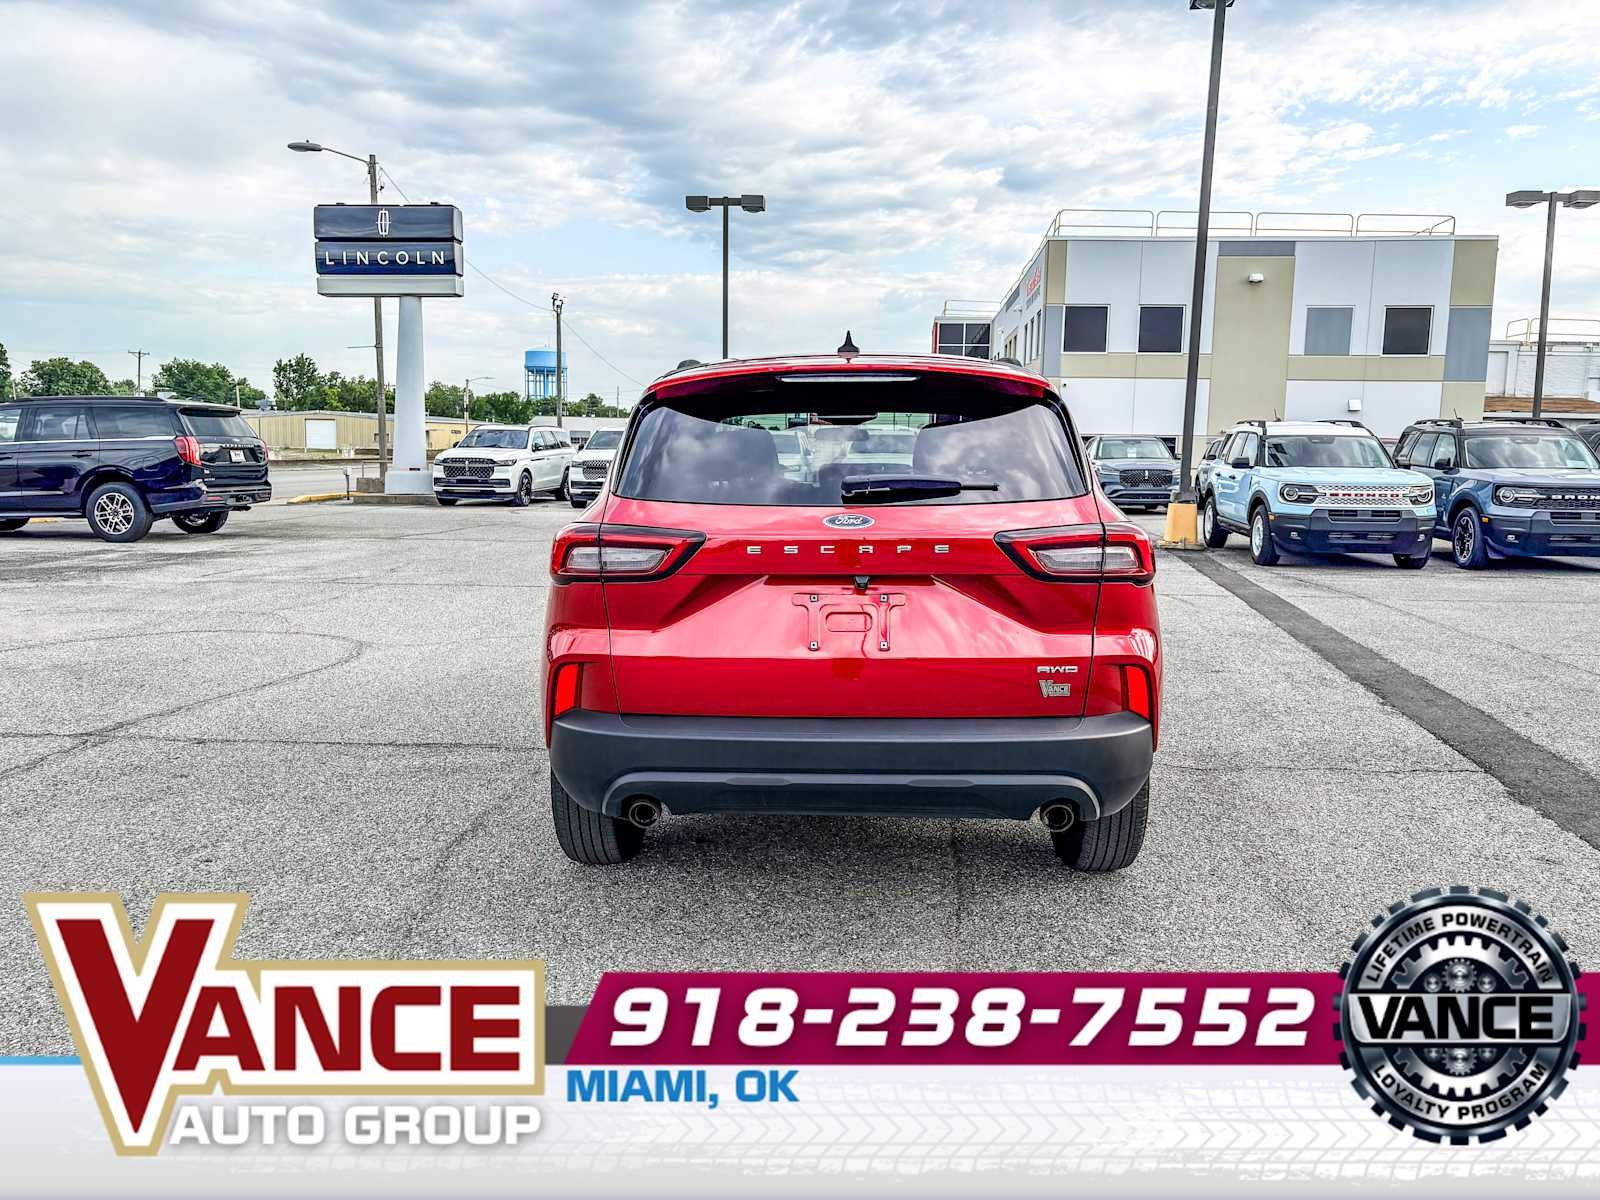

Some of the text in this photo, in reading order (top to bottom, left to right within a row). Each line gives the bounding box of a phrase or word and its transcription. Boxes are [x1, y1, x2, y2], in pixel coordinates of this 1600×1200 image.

[325, 251, 445, 265] LINCOLN
[835, 515, 863, 525] Ford
[747, 545, 949, 554] ESCAPE
